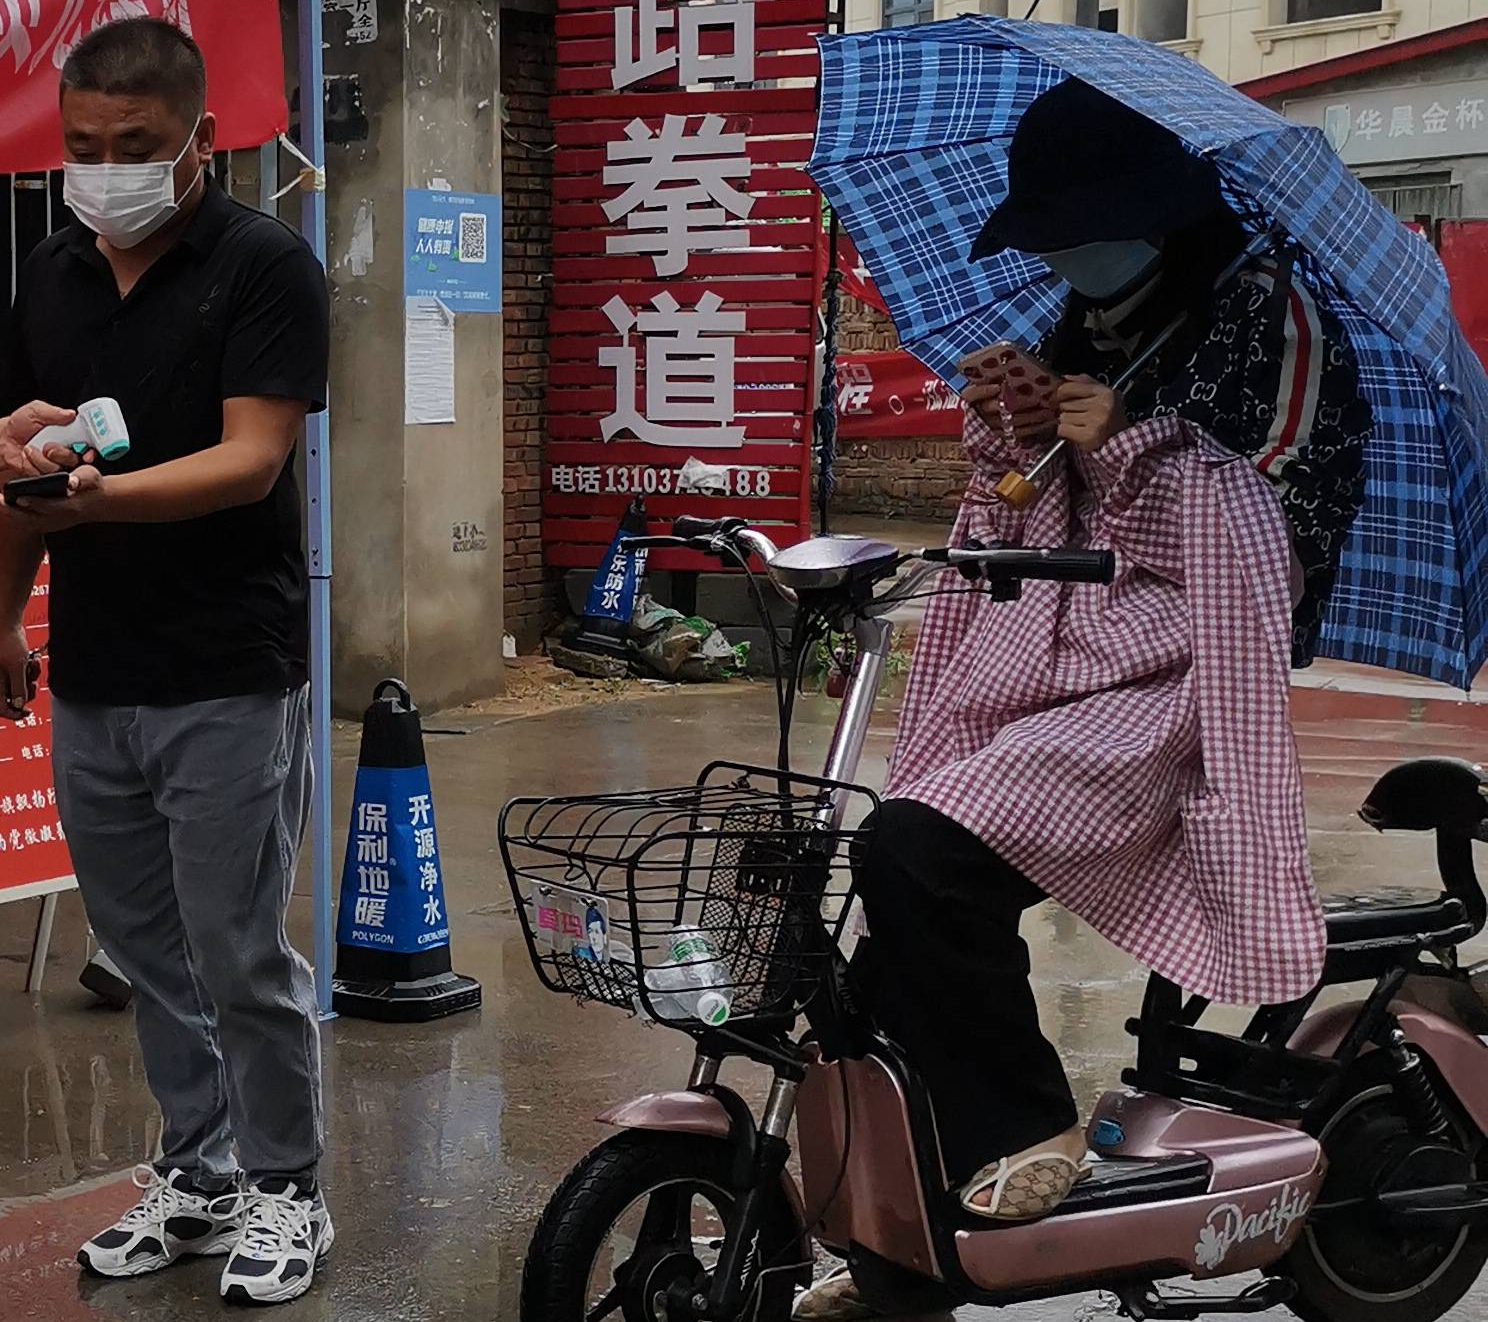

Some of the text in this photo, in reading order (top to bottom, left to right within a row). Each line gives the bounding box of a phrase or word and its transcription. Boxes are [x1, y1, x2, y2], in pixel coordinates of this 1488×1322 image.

[1355, 97, 1486, 140] 华晨金杯
[551, 465, 601, 493] 电话
[355, 802, 390, 928] 保利地暖
[408, 794, 443, 926] 开源净水
[352, 930, 394, 945] POLYGON
